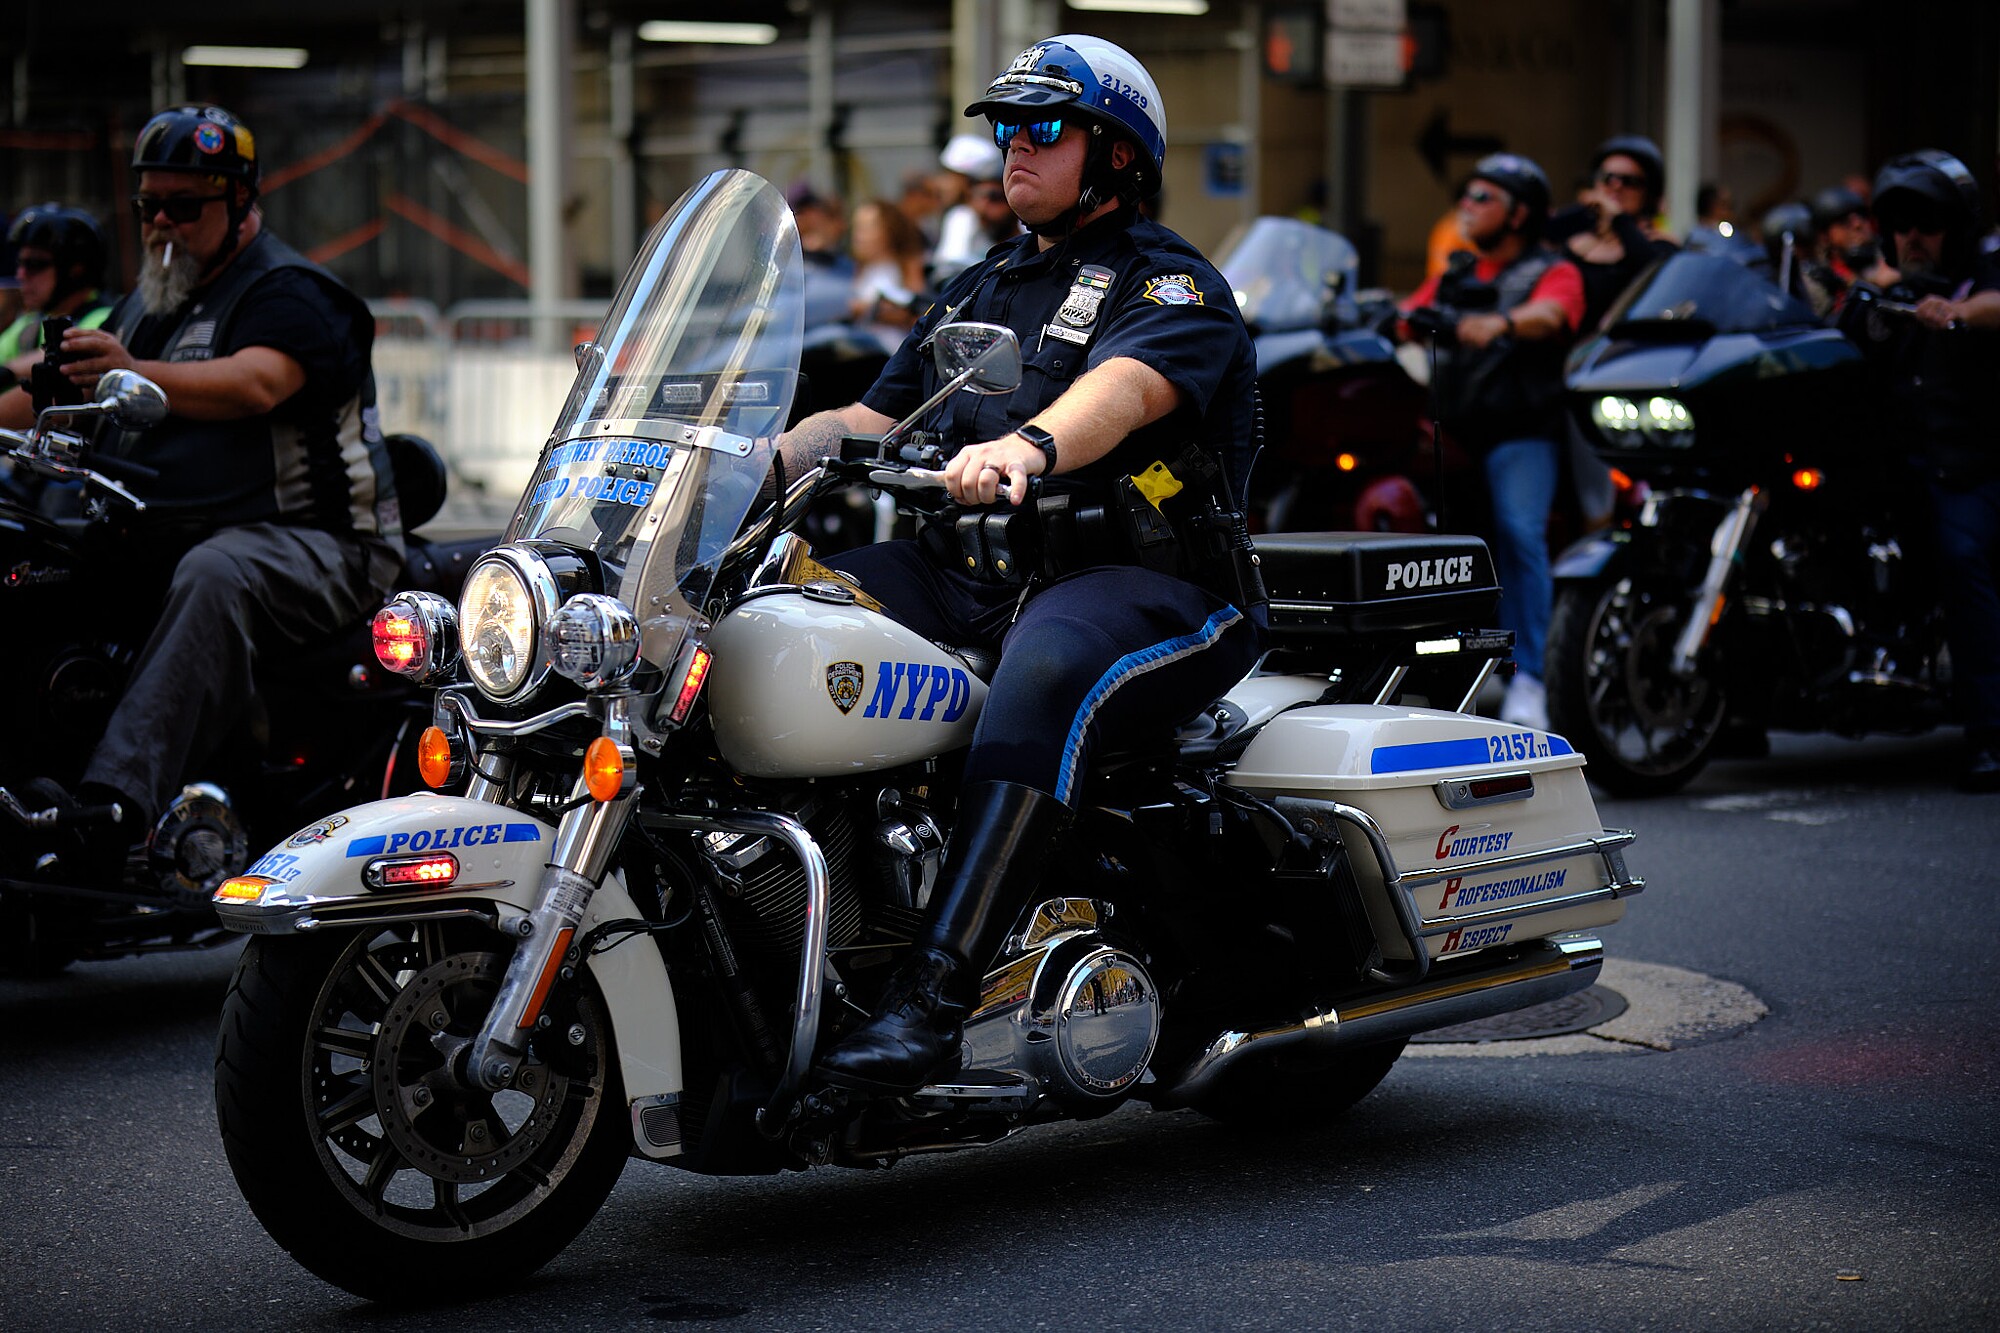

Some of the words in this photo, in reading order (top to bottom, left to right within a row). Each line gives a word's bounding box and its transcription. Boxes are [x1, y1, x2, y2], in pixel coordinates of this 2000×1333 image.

[1102, 73, 1148, 110] 21229
[1151, 274, 1189, 284] NYPD
[546, 441, 602, 469] HIGHWAY
[603, 440, 670, 469] PATROL
[530, 479, 570, 507] NYPD
[572, 477, 655, 507] POLICE
[1385, 555, 1473, 591] POLICE
[828, 669, 862, 680] DEPARTMENT
[834, 663, 856, 671] POLICE
[863, 661, 971, 722] NYPD
[1490, 732, 1537, 763] 2157
[1538, 743, 1549, 757] 17
[387, 823, 502, 853] POLICE
[1435, 824, 1514, 860] COURTESY
[1439, 868, 1567, 910] PROFESSIONALISM
